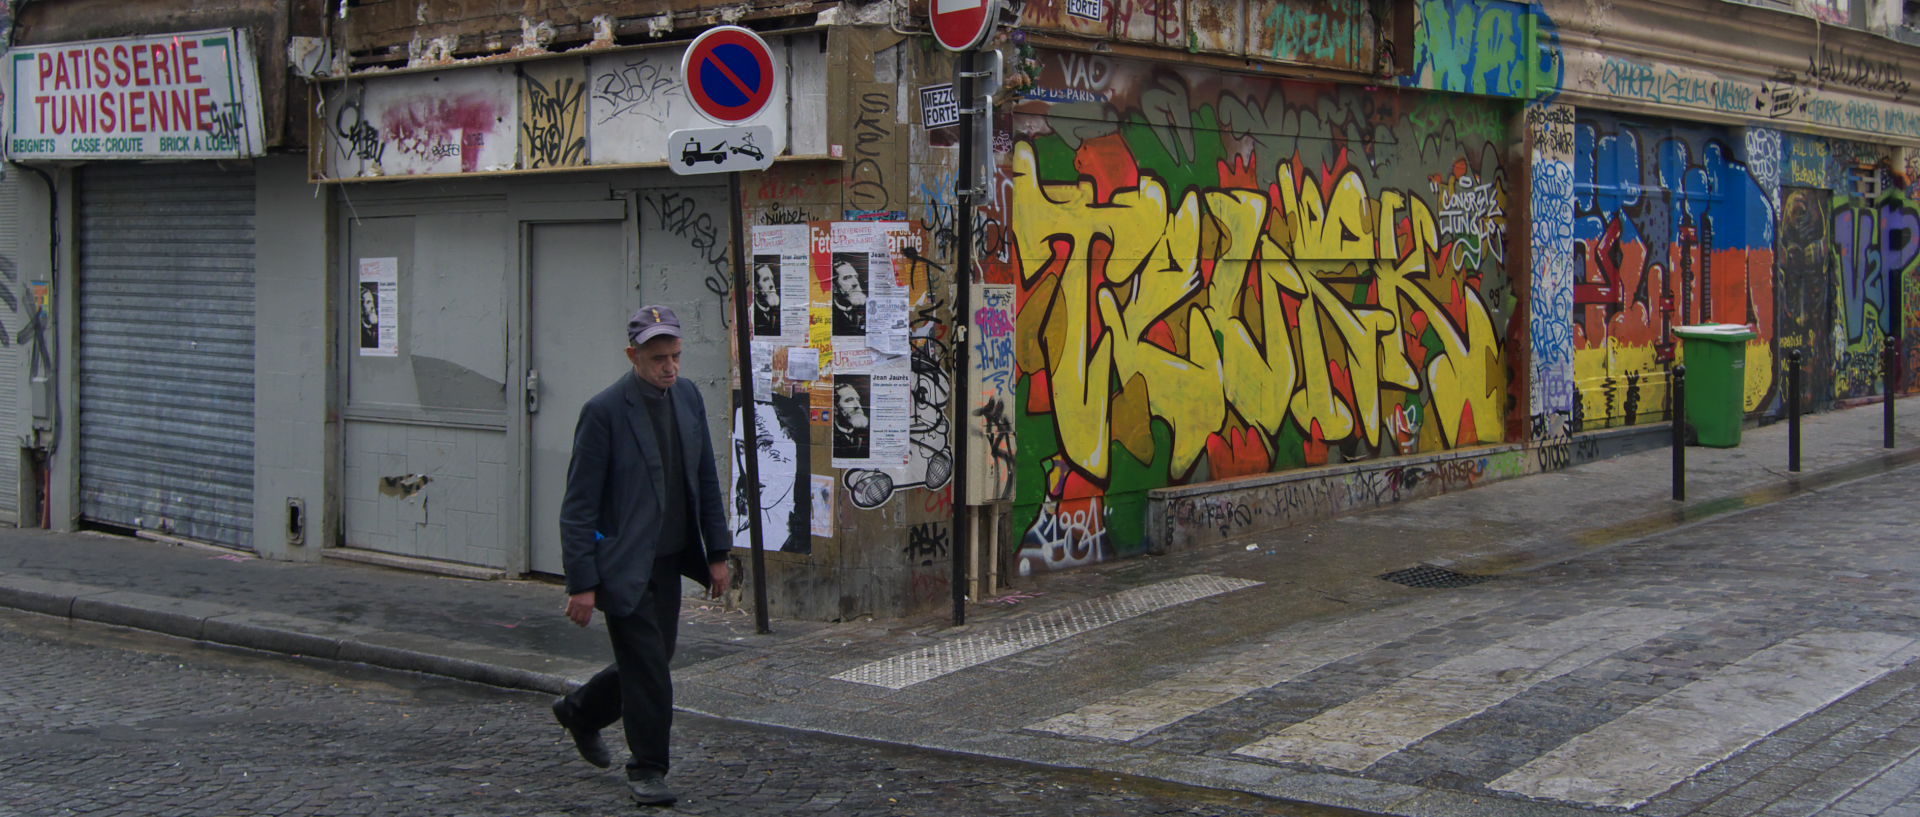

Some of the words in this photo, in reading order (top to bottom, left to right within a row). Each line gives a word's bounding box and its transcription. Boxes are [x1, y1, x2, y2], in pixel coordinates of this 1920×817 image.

[1071, 0, 1097, 17] FORTE
[38, 40, 202, 91] PATISSERIE
[1067, 89, 1095, 102] PARIS
[35, 88, 213, 135] TUNISIENNE
[926, 106, 957, 125] FORTE
[13, 139, 55, 153] BEIGNETS
[71, 137, 143, 153] CASSE-CROUTE
[160, 137, 190, 152] BRICK
[193, 138, 201, 151] A
[811, 227, 831, 254] Fêt
